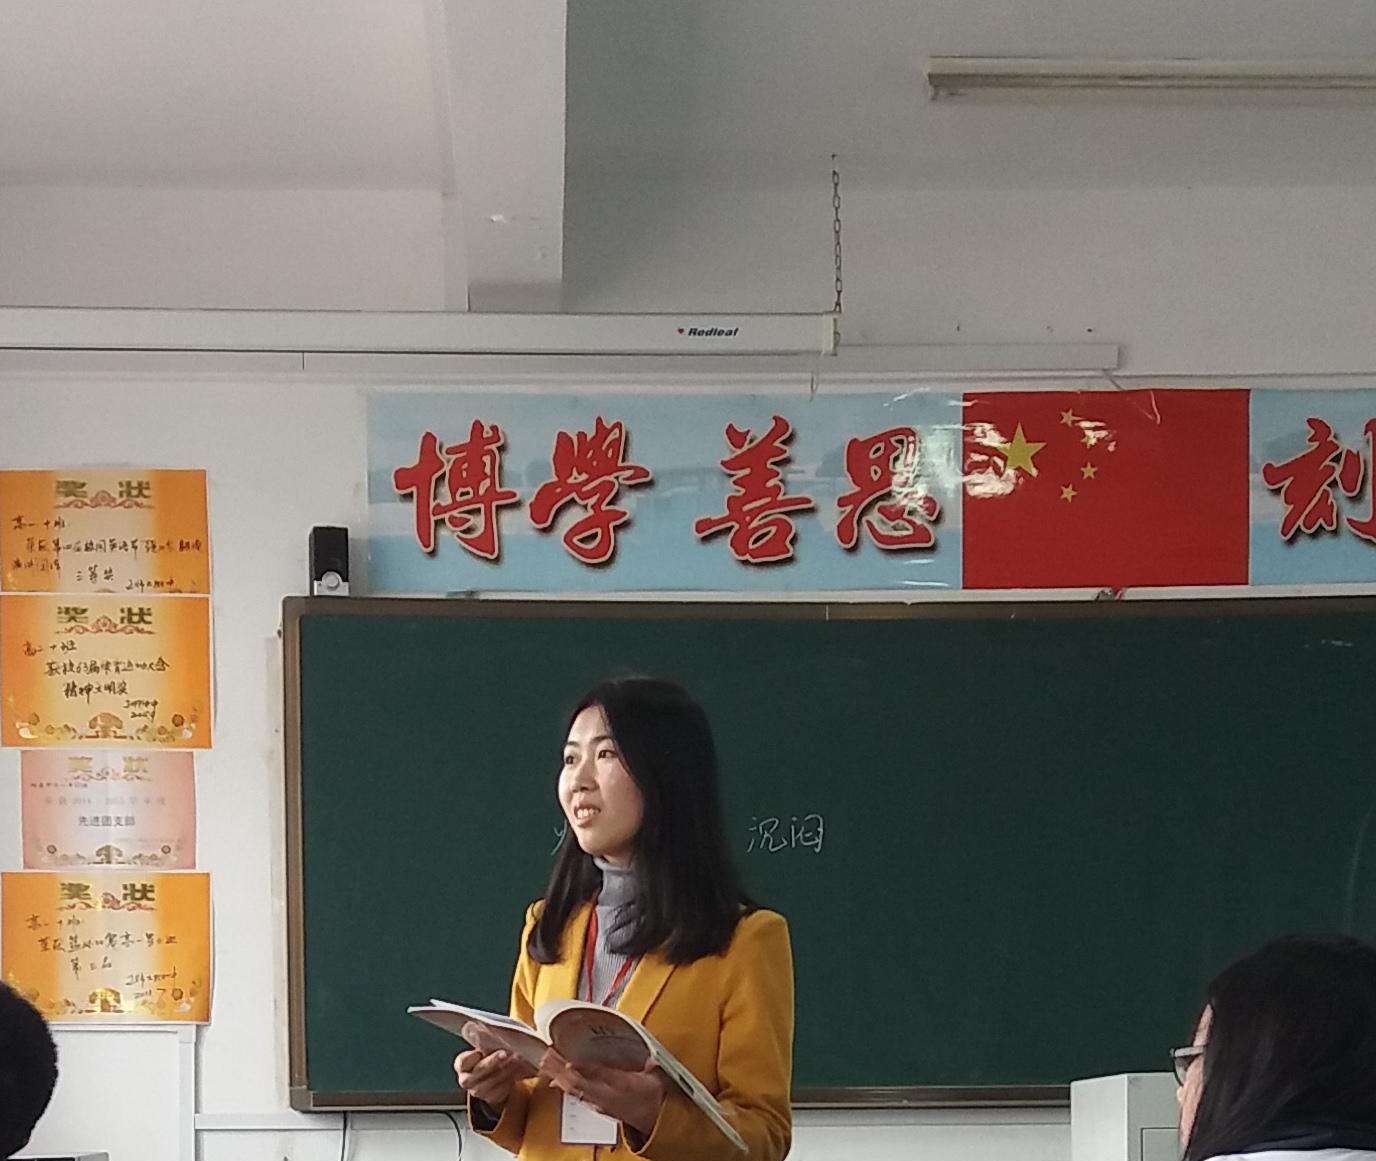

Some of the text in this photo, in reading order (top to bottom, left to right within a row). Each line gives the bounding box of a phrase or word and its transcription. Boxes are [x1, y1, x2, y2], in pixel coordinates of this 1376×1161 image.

[688, 327, 739, 337] Redleaf
[78, 815, 136, 827] 先进团支部
[747, 813, 824, 853] 沉闷
